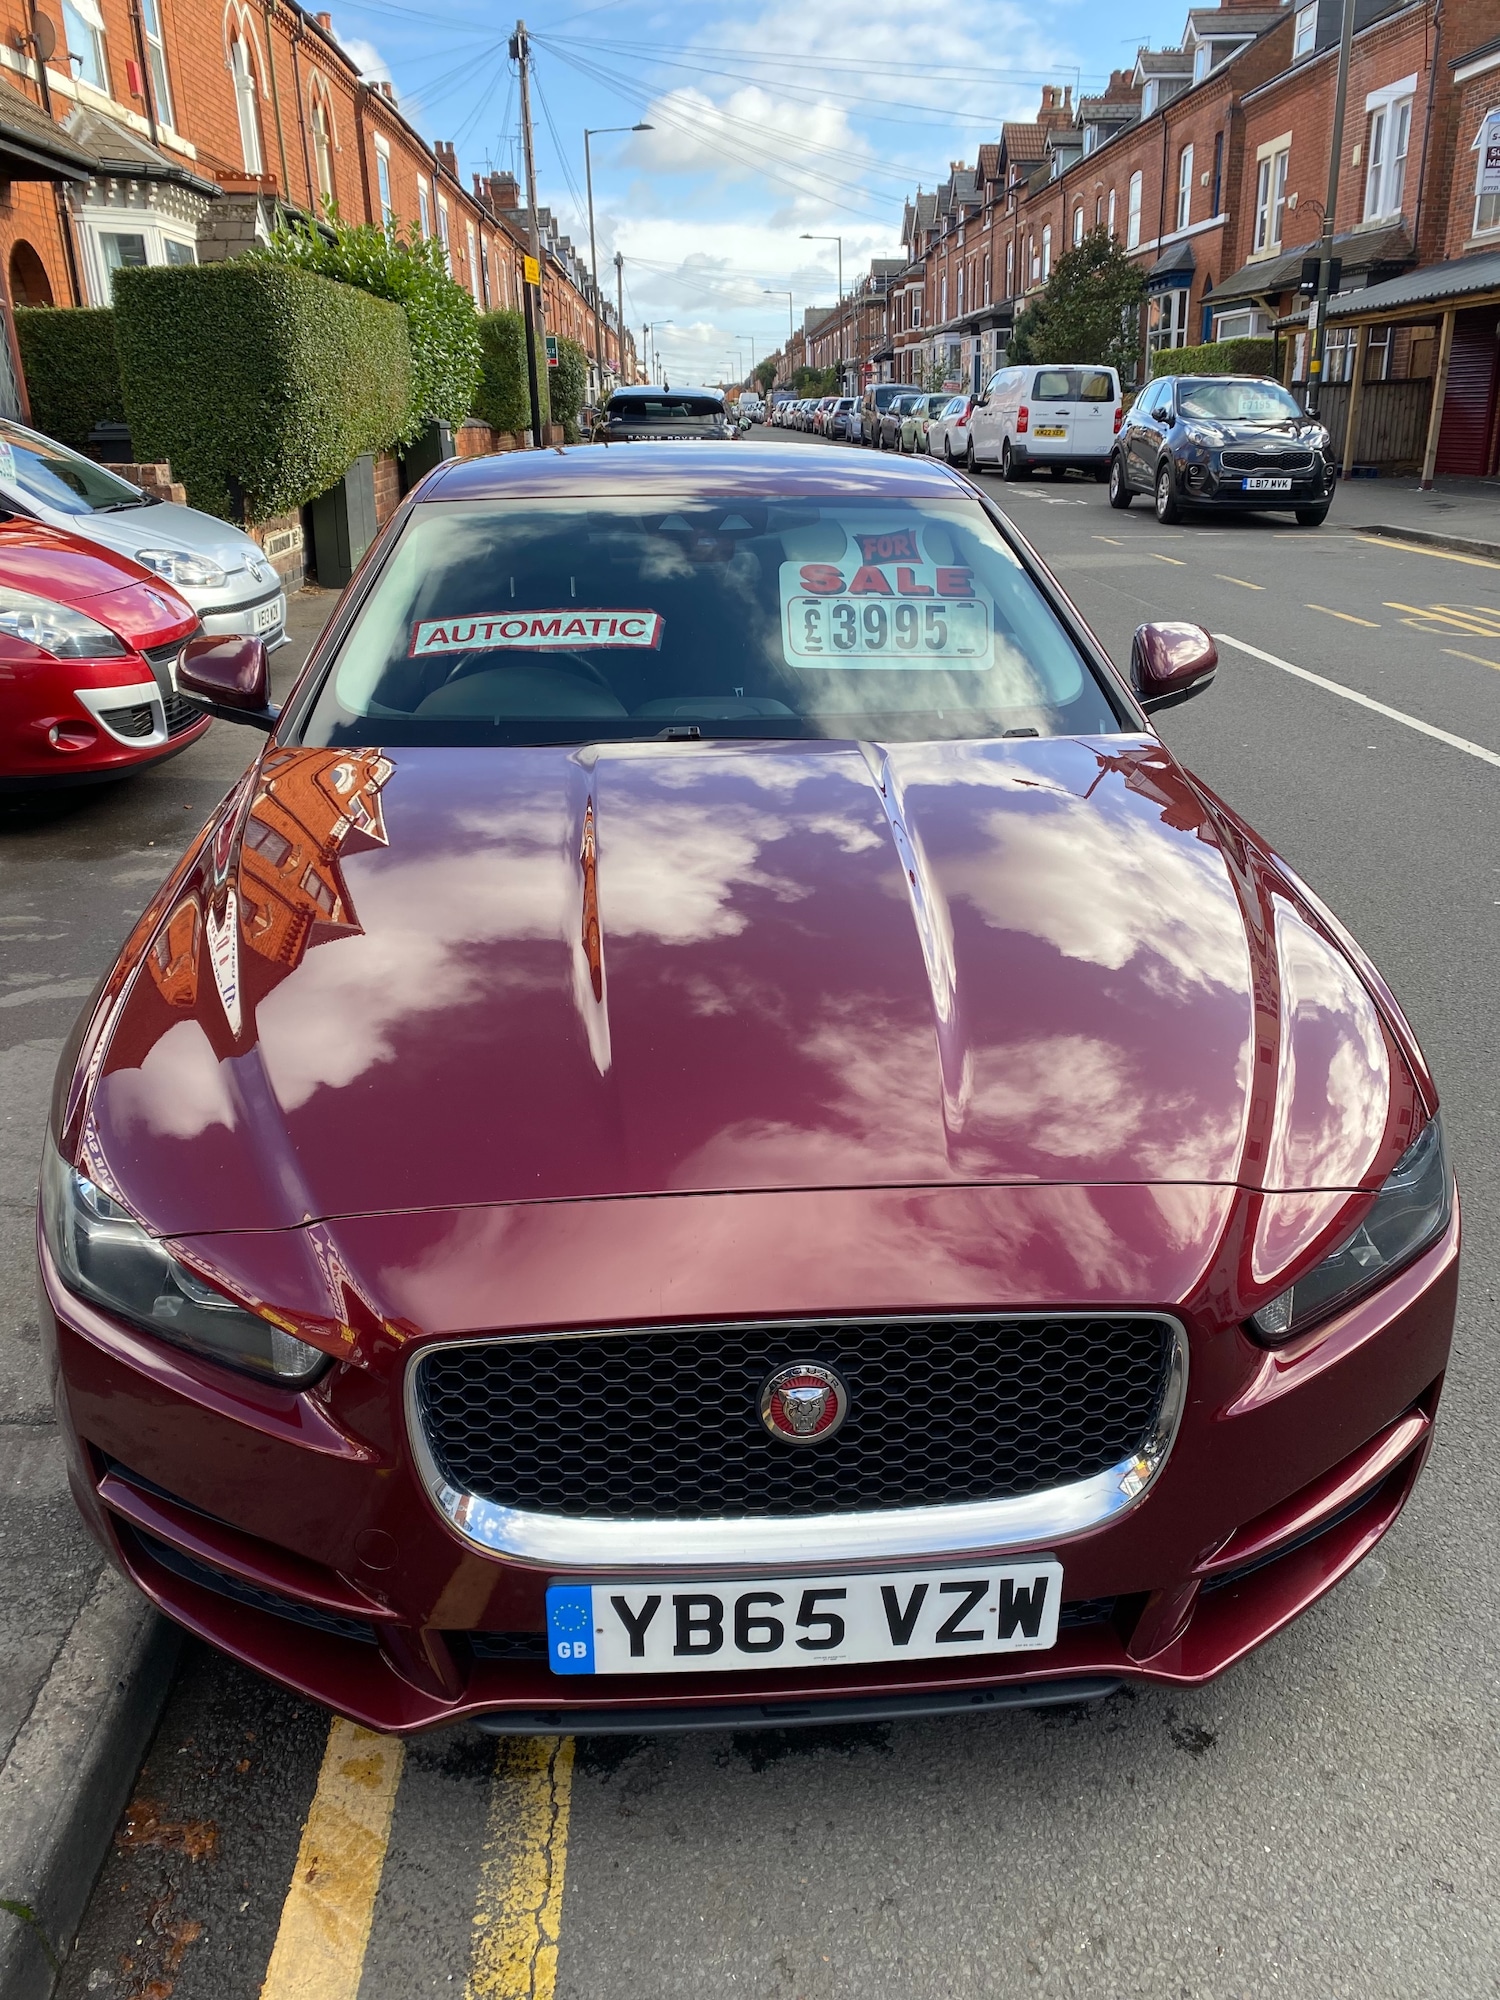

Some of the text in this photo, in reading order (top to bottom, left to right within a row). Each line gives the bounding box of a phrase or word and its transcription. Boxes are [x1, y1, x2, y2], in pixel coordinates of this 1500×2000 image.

[862, 535, 911, 561] FOR
[800, 564, 976, 598] SALE
[425, 618, 647, 647] AUTOMATIC
[804, 603, 948, 650] £3995
[610, 1576, 1050, 1657] YB65 VZW
[557, 1641, 587, 1658] GB
